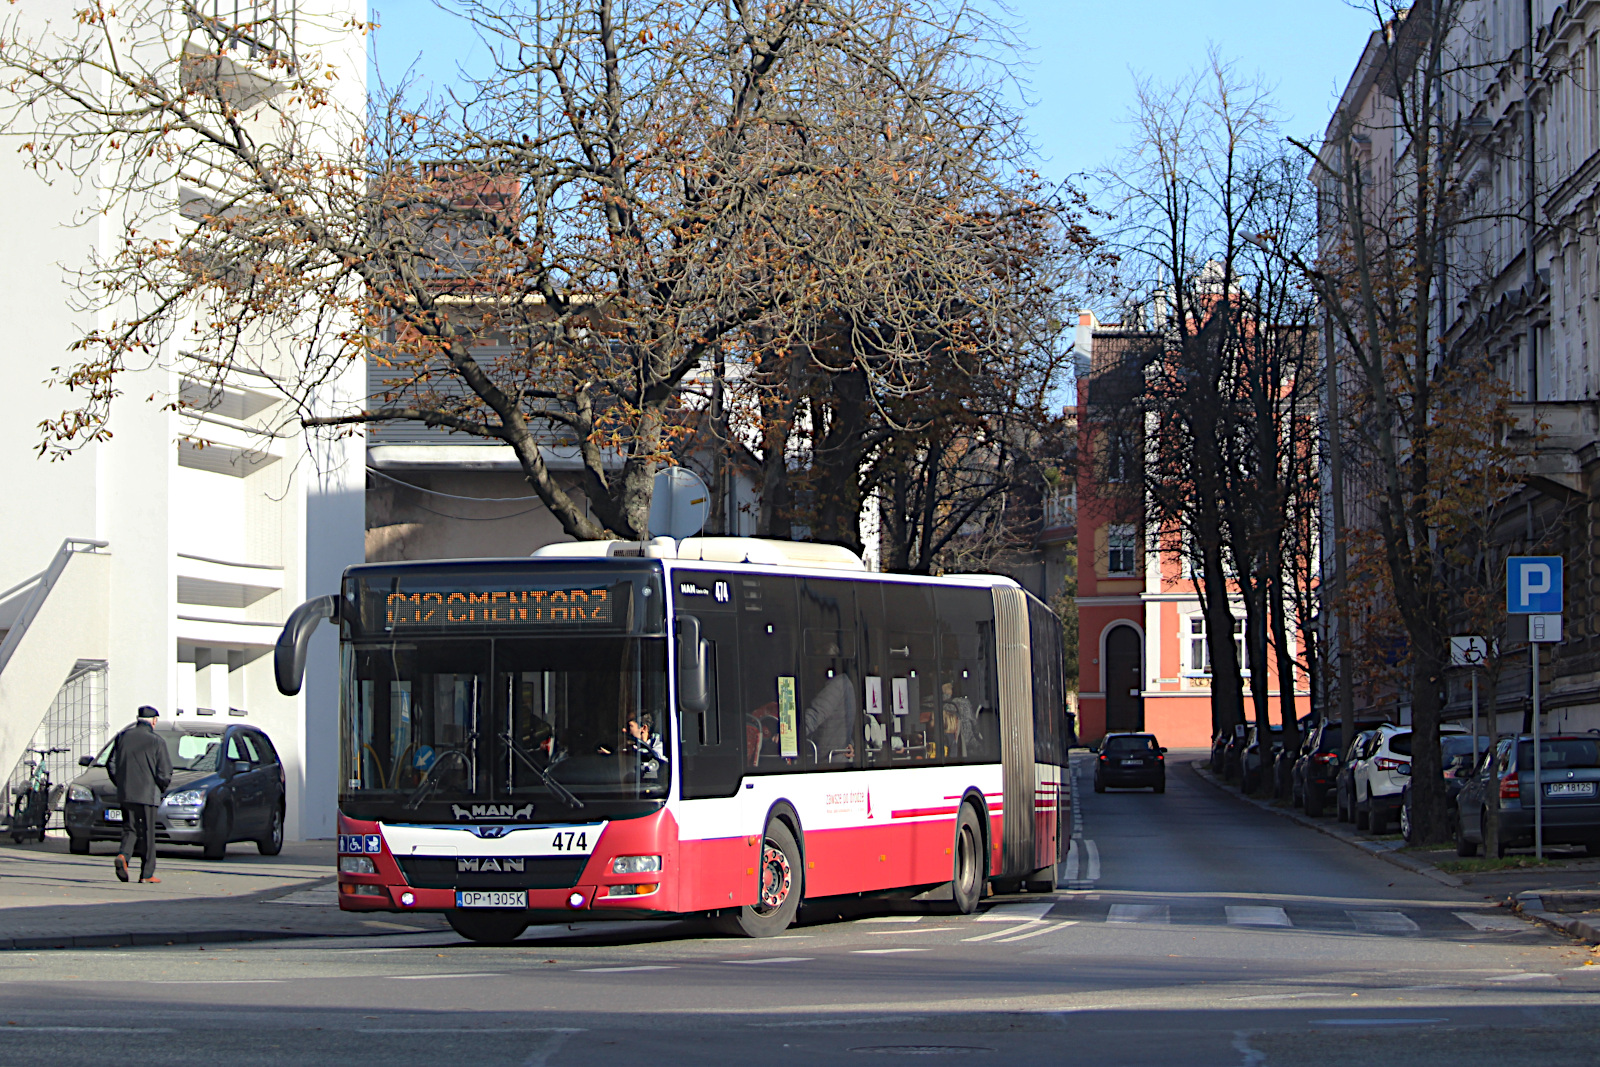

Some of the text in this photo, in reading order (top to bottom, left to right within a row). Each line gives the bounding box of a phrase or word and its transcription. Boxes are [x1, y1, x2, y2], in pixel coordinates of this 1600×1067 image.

[1520, 563, 1551, 606] P
[472, 804, 514, 816] MAN
[552, 832, 588, 851] 474
[457, 857, 525, 872] MAN
[464, 893, 482, 905] OP
[487, 892, 524, 905] 1305K
